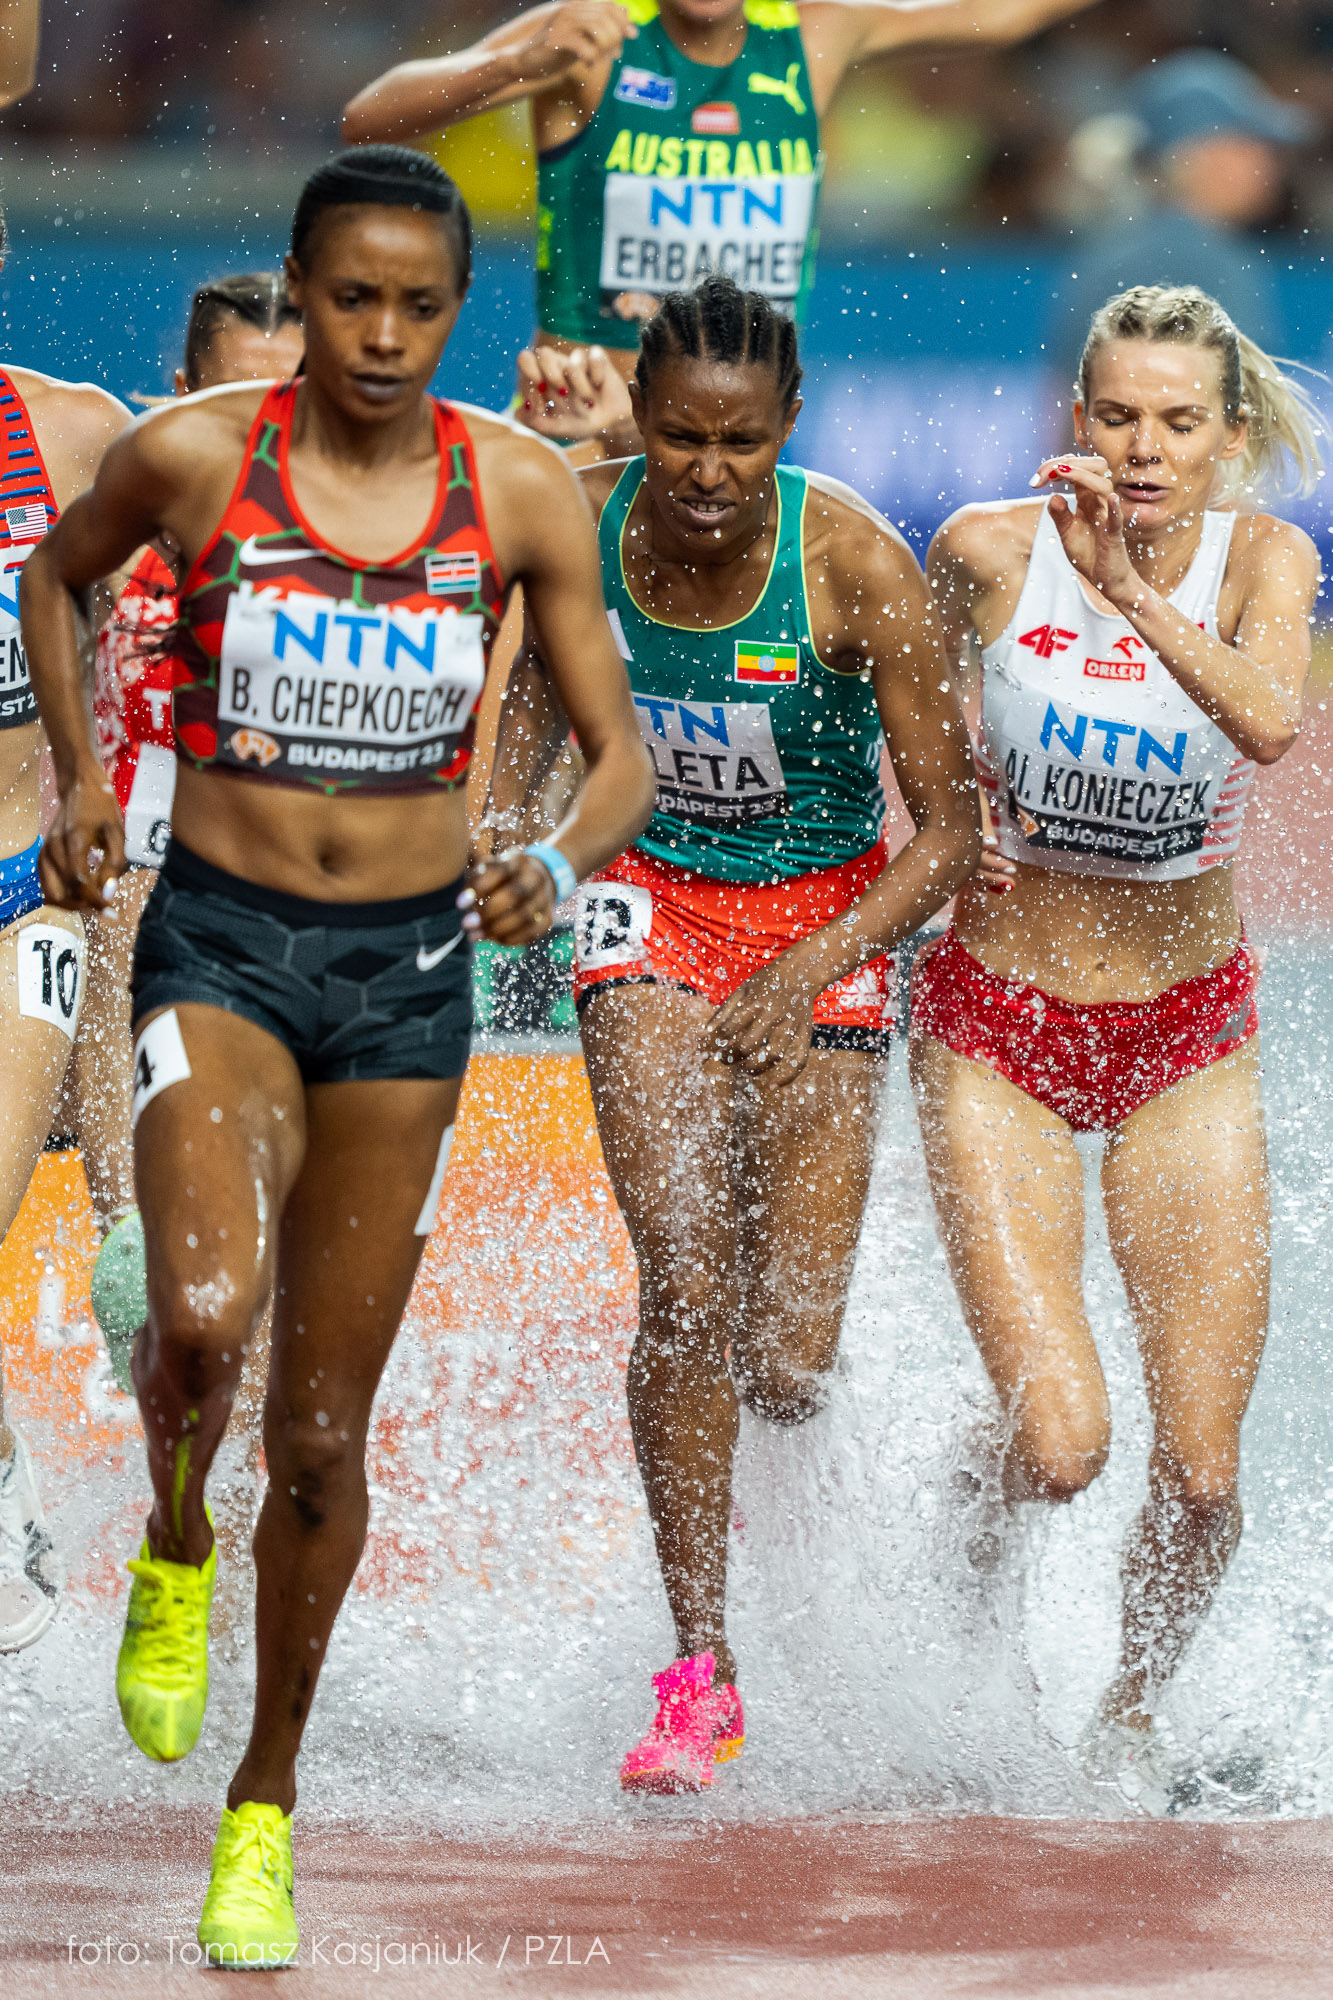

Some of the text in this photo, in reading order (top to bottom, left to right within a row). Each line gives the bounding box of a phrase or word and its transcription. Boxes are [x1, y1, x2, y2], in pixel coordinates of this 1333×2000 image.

[605, 129, 813, 180] AUSTRALIA
[651, 184, 783, 228] NTN
[274, 609, 437, 675] NTN
[1018, 624, 1079, 659] 4F
[1086, 662, 1143, 680] ORLEN
[231, 667, 257, 717] B.
[271, 675, 467, 734] CHEPKOECH
[1040, 701, 1188, 777] NTN
[1041, 764, 1215, 826] KONIECZEK
[32, 939, 78, 1019] 10
